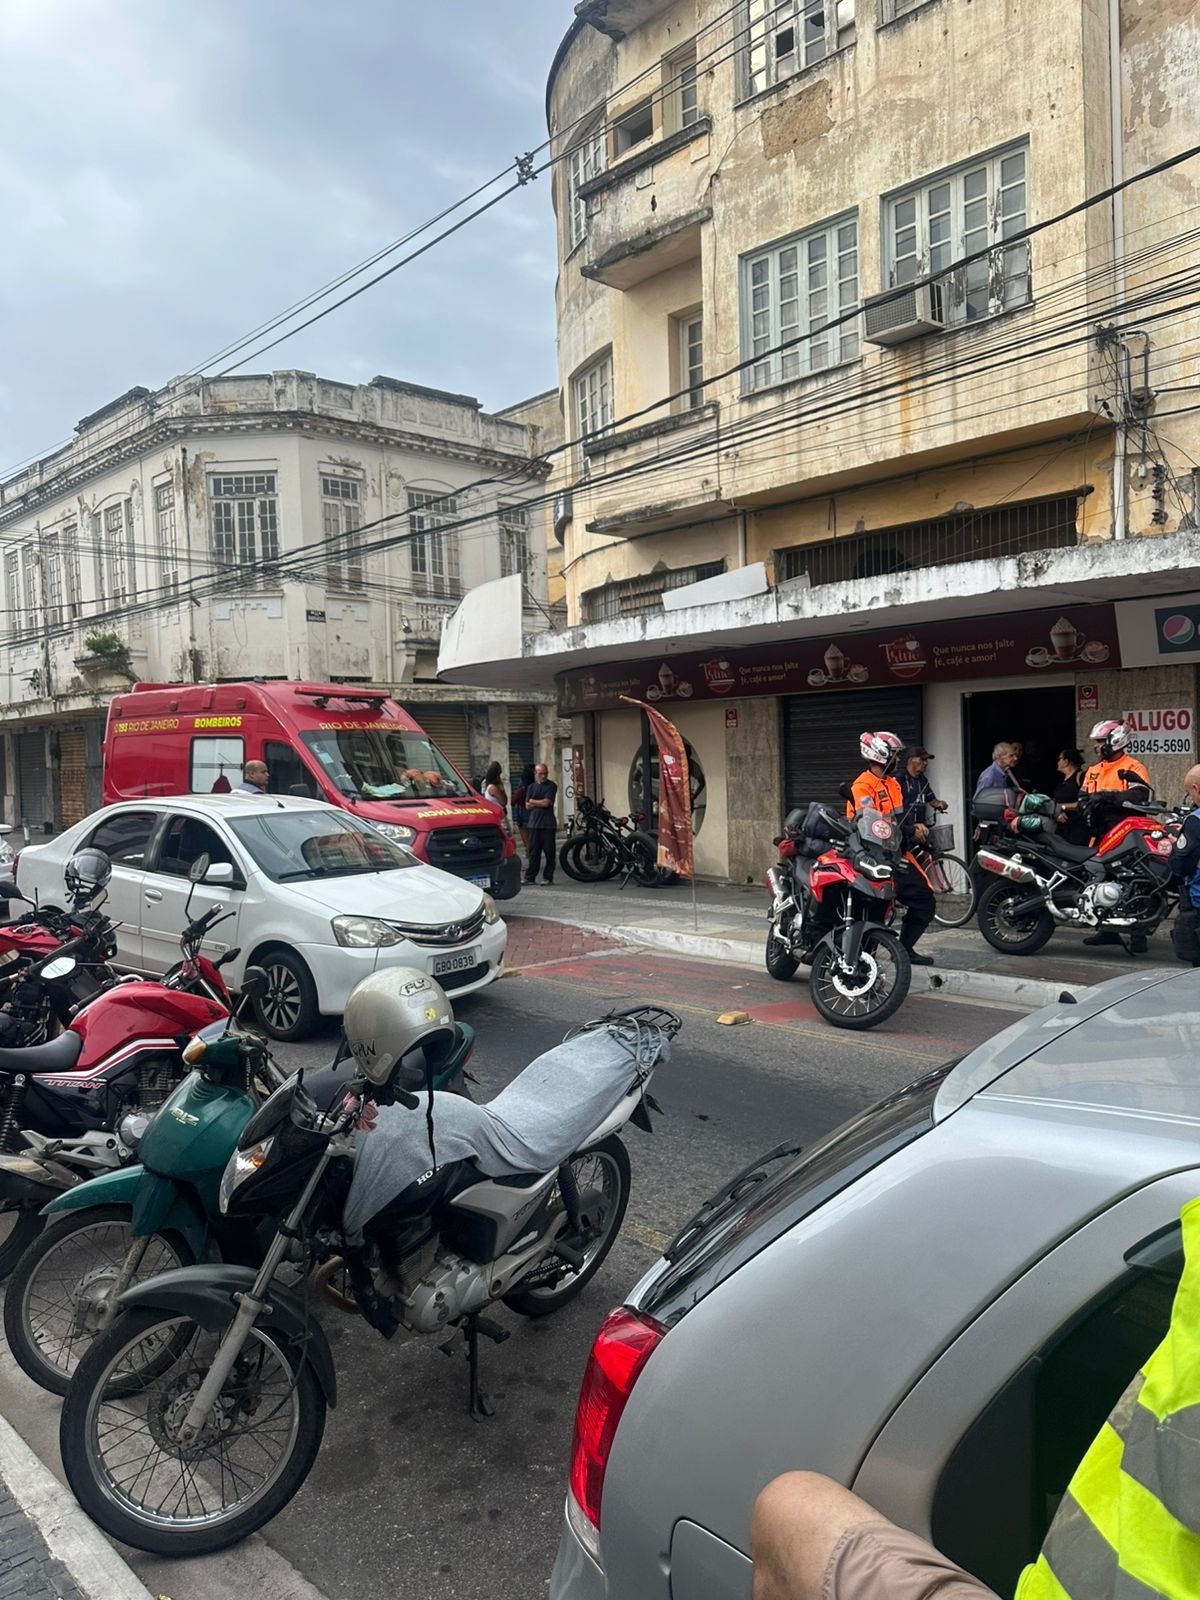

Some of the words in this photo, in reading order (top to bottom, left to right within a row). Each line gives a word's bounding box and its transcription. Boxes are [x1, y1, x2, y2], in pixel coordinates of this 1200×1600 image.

[933, 646, 949, 655] Que
[951, 645, 976, 653] nunca
[977, 642, 992, 650] nos
[995, 639, 1015, 650] falte
[946, 655, 963, 666] café
[972, 652, 996, 662] amor!
[739, 667, 751, 675] Que
[784, 661, 799, 671] falte
[129, 721, 140, 732] RIO
[140, 720, 150, 731] DE
[150, 719, 179, 730] JANEIRO
[194, 717, 242, 728] BOMBEIROS
[319, 722, 342, 730] RIO
[343, 721, 359, 729] DE
[360, 722, 408, 731] JANEIRO
[1126, 710, 1190, 731] ALUGO
[1127, 738, 1190, 753] 99845-5690
